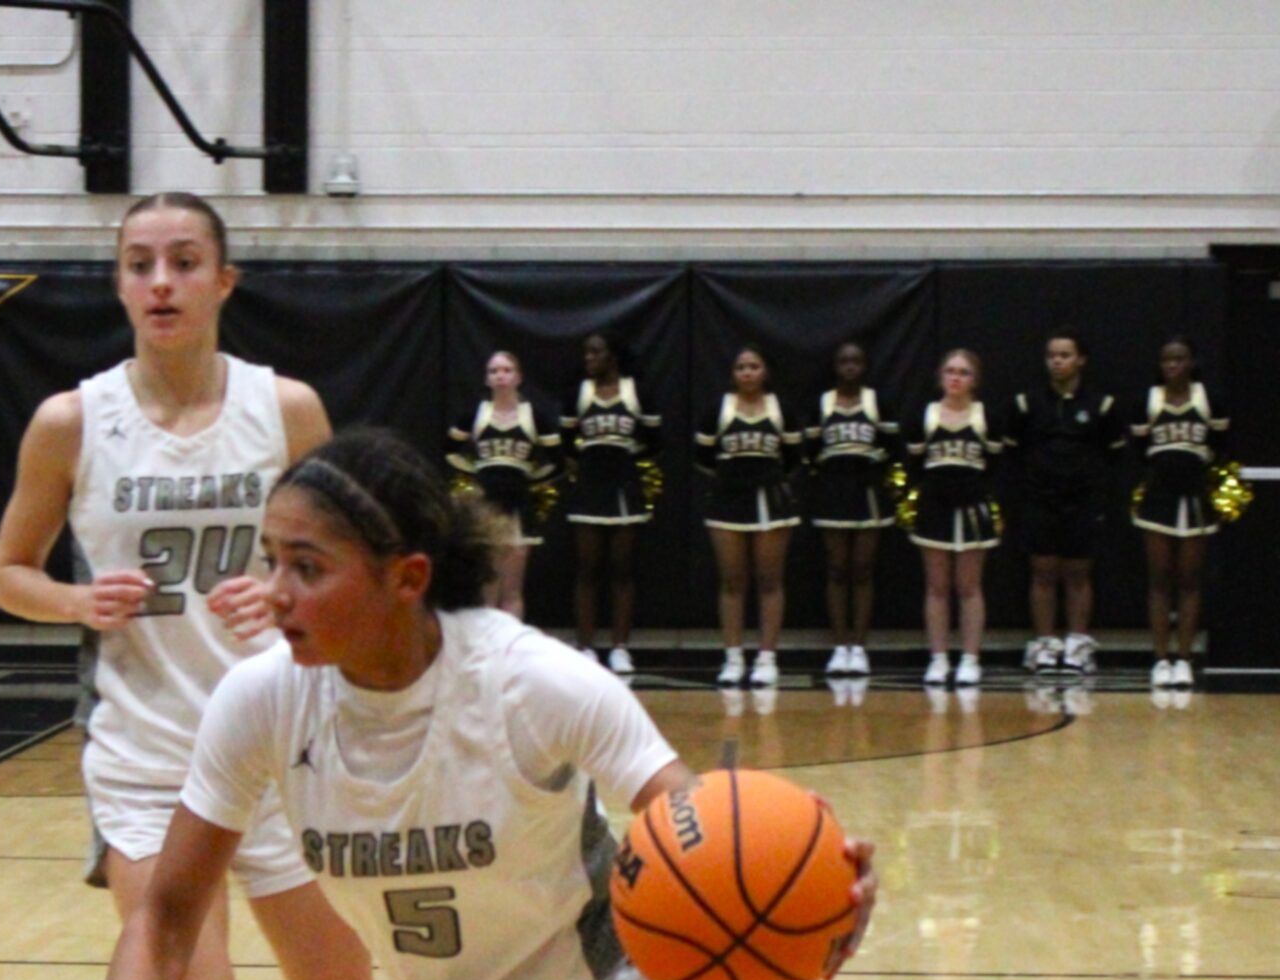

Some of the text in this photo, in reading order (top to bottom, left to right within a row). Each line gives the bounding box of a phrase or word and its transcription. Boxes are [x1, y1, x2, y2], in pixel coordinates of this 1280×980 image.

[113, 472, 261, 512] STREAKS
[302, 819, 496, 877] STREAKS
[383, 886, 462, 959] 5
